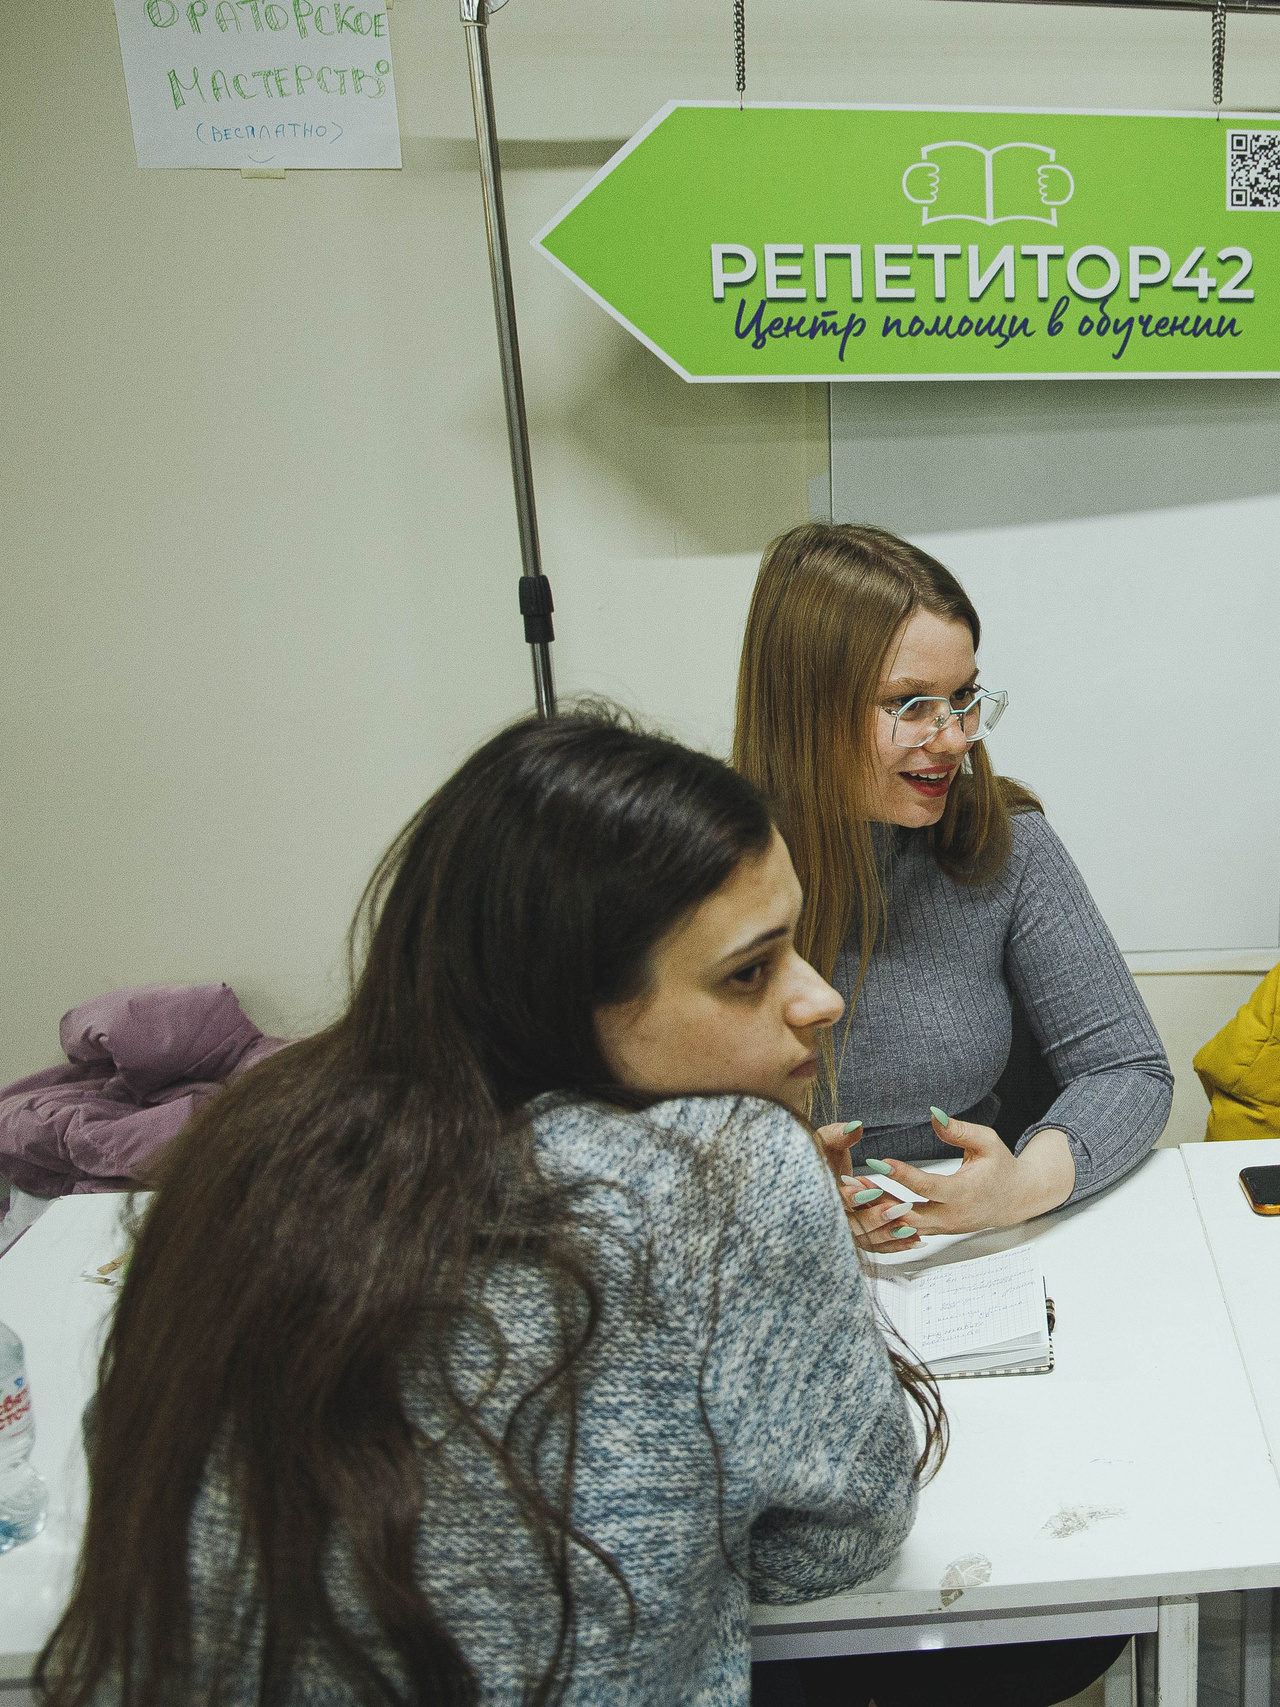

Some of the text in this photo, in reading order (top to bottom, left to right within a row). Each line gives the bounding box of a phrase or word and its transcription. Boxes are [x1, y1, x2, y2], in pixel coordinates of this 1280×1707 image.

[144, 0, 387, 40] ОРАТОРСКОЕ
[167, 59, 390, 110] МАСТЕРСТВО
[710, 243, 1256, 301] РЕПЕТИТОР42
[734, 295, 1243, 362] Центр помощи в обучении
